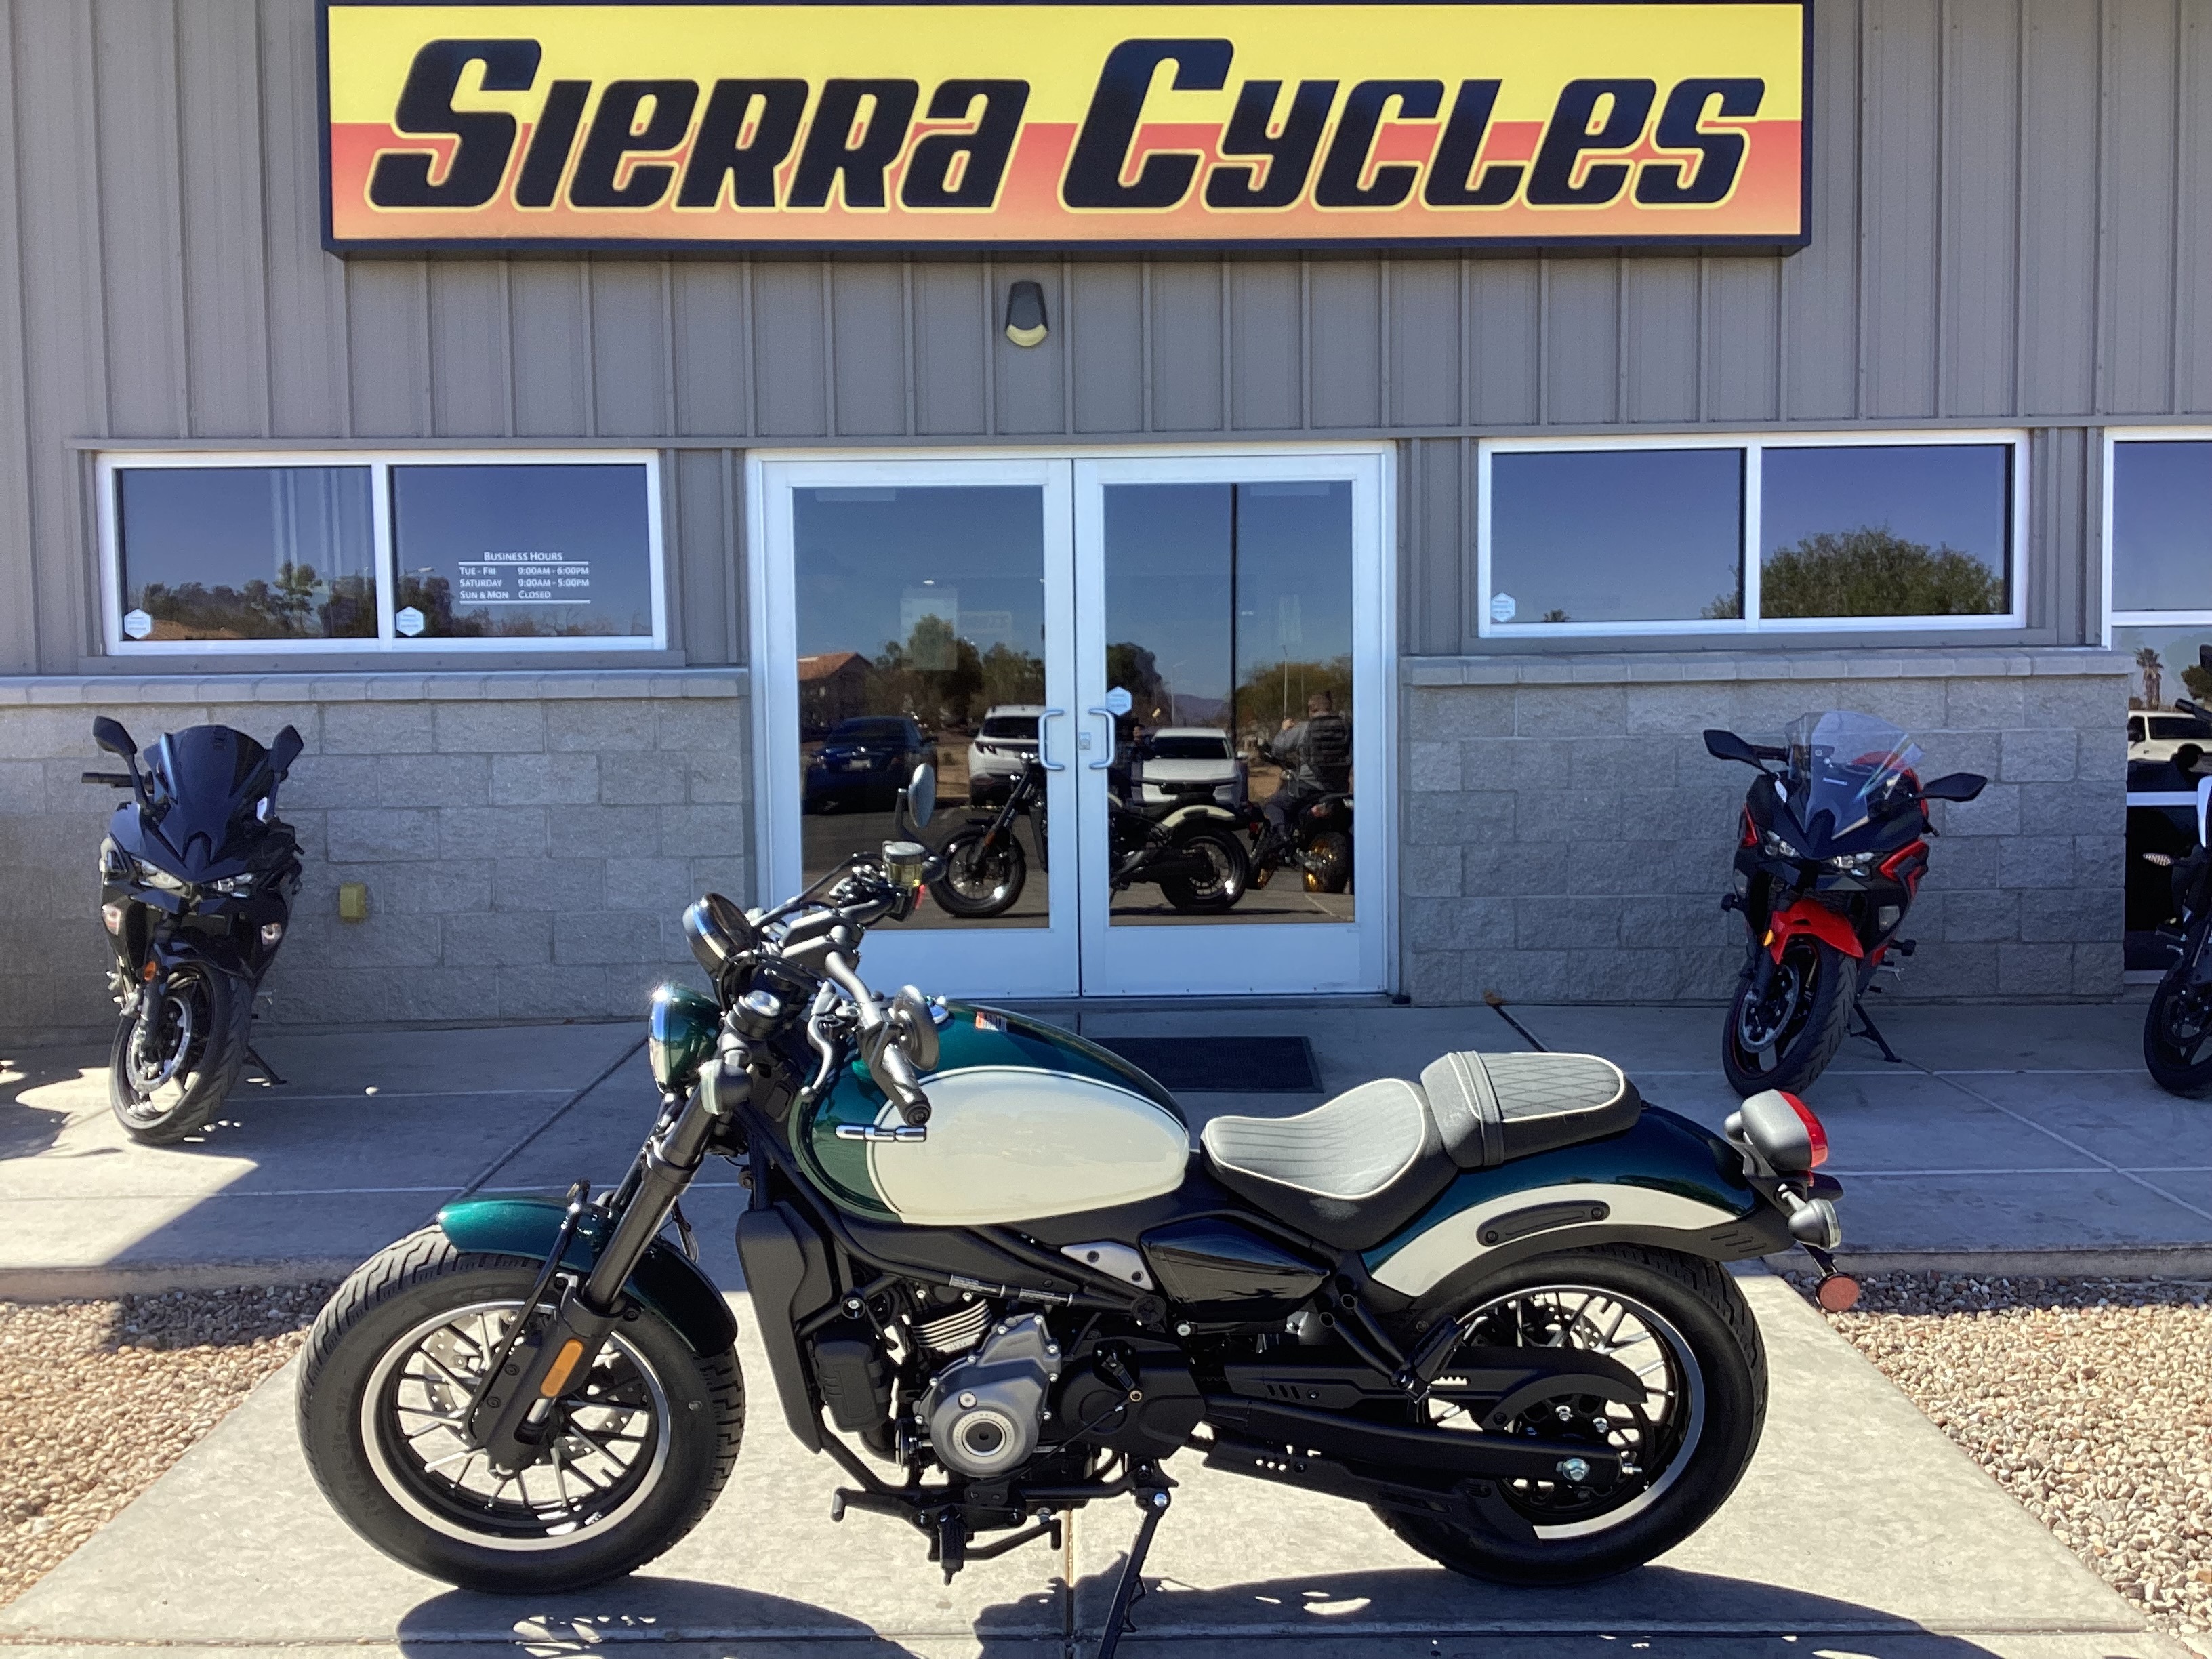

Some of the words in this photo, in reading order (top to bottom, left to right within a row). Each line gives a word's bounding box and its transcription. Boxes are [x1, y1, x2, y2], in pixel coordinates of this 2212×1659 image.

[517, 567, 550, 575] 9:00AM
[556, 567, 590, 575] 6:00PM
[459, 578, 502, 588] SATURDAY
[518, 578, 551, 588] 9:00AM
[558, 578, 591, 588] 5:00PM
[459, 590, 478, 600] SUN
[487, 590, 509, 600] MON
[518, 590, 552, 599] CLOSED
